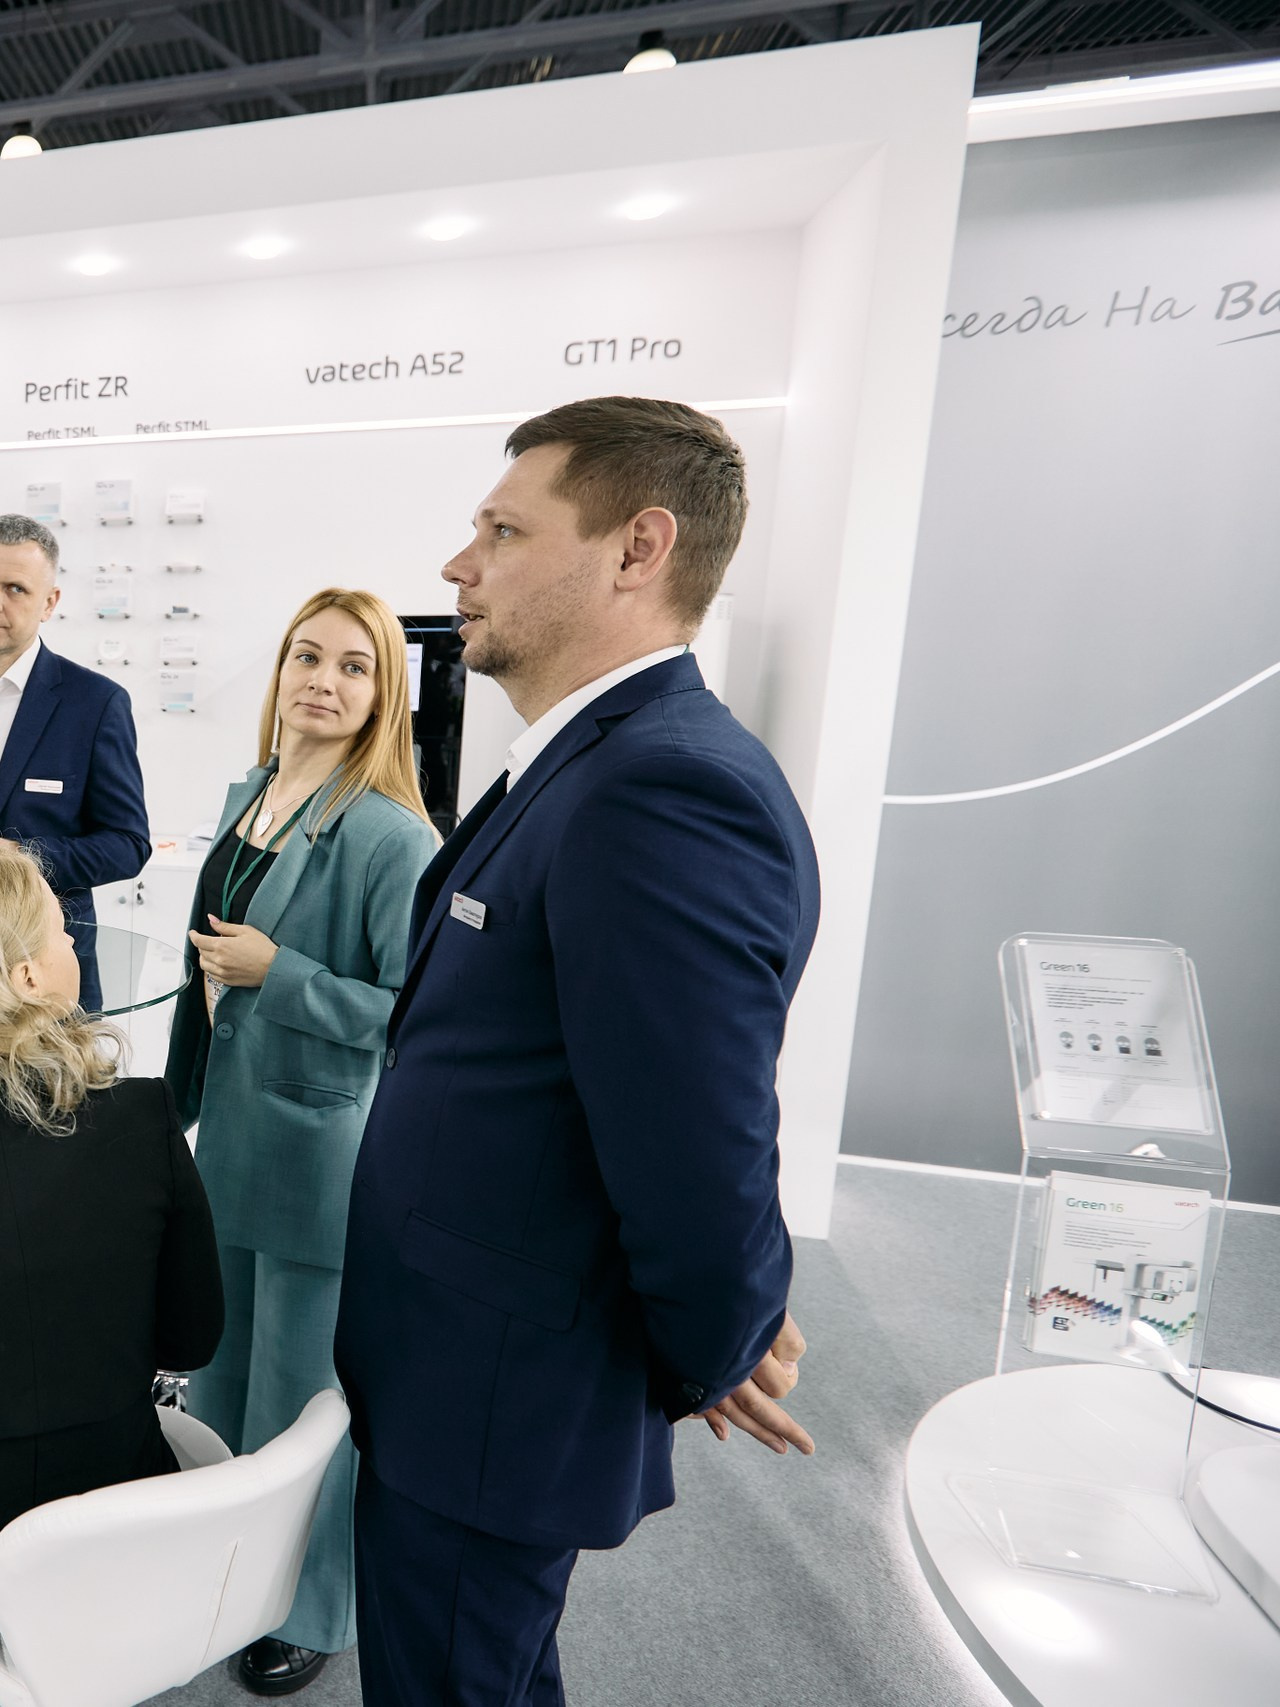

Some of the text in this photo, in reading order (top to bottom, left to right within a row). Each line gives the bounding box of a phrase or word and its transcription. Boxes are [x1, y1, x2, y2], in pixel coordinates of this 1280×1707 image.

[1104, 286, 1197, 328] На
[564, 336, 683, 367] GT1 Pro
[305, 350, 465, 385] vatech A52
[24, 375, 129, 403] Perfit ZR
[27, 426, 99, 441] Perfit TSML
[135, 419, 211, 434] Perfit STML
[1040, 961, 1091, 974] Green 16
[1066, 1197, 1125, 1213] Green 16
